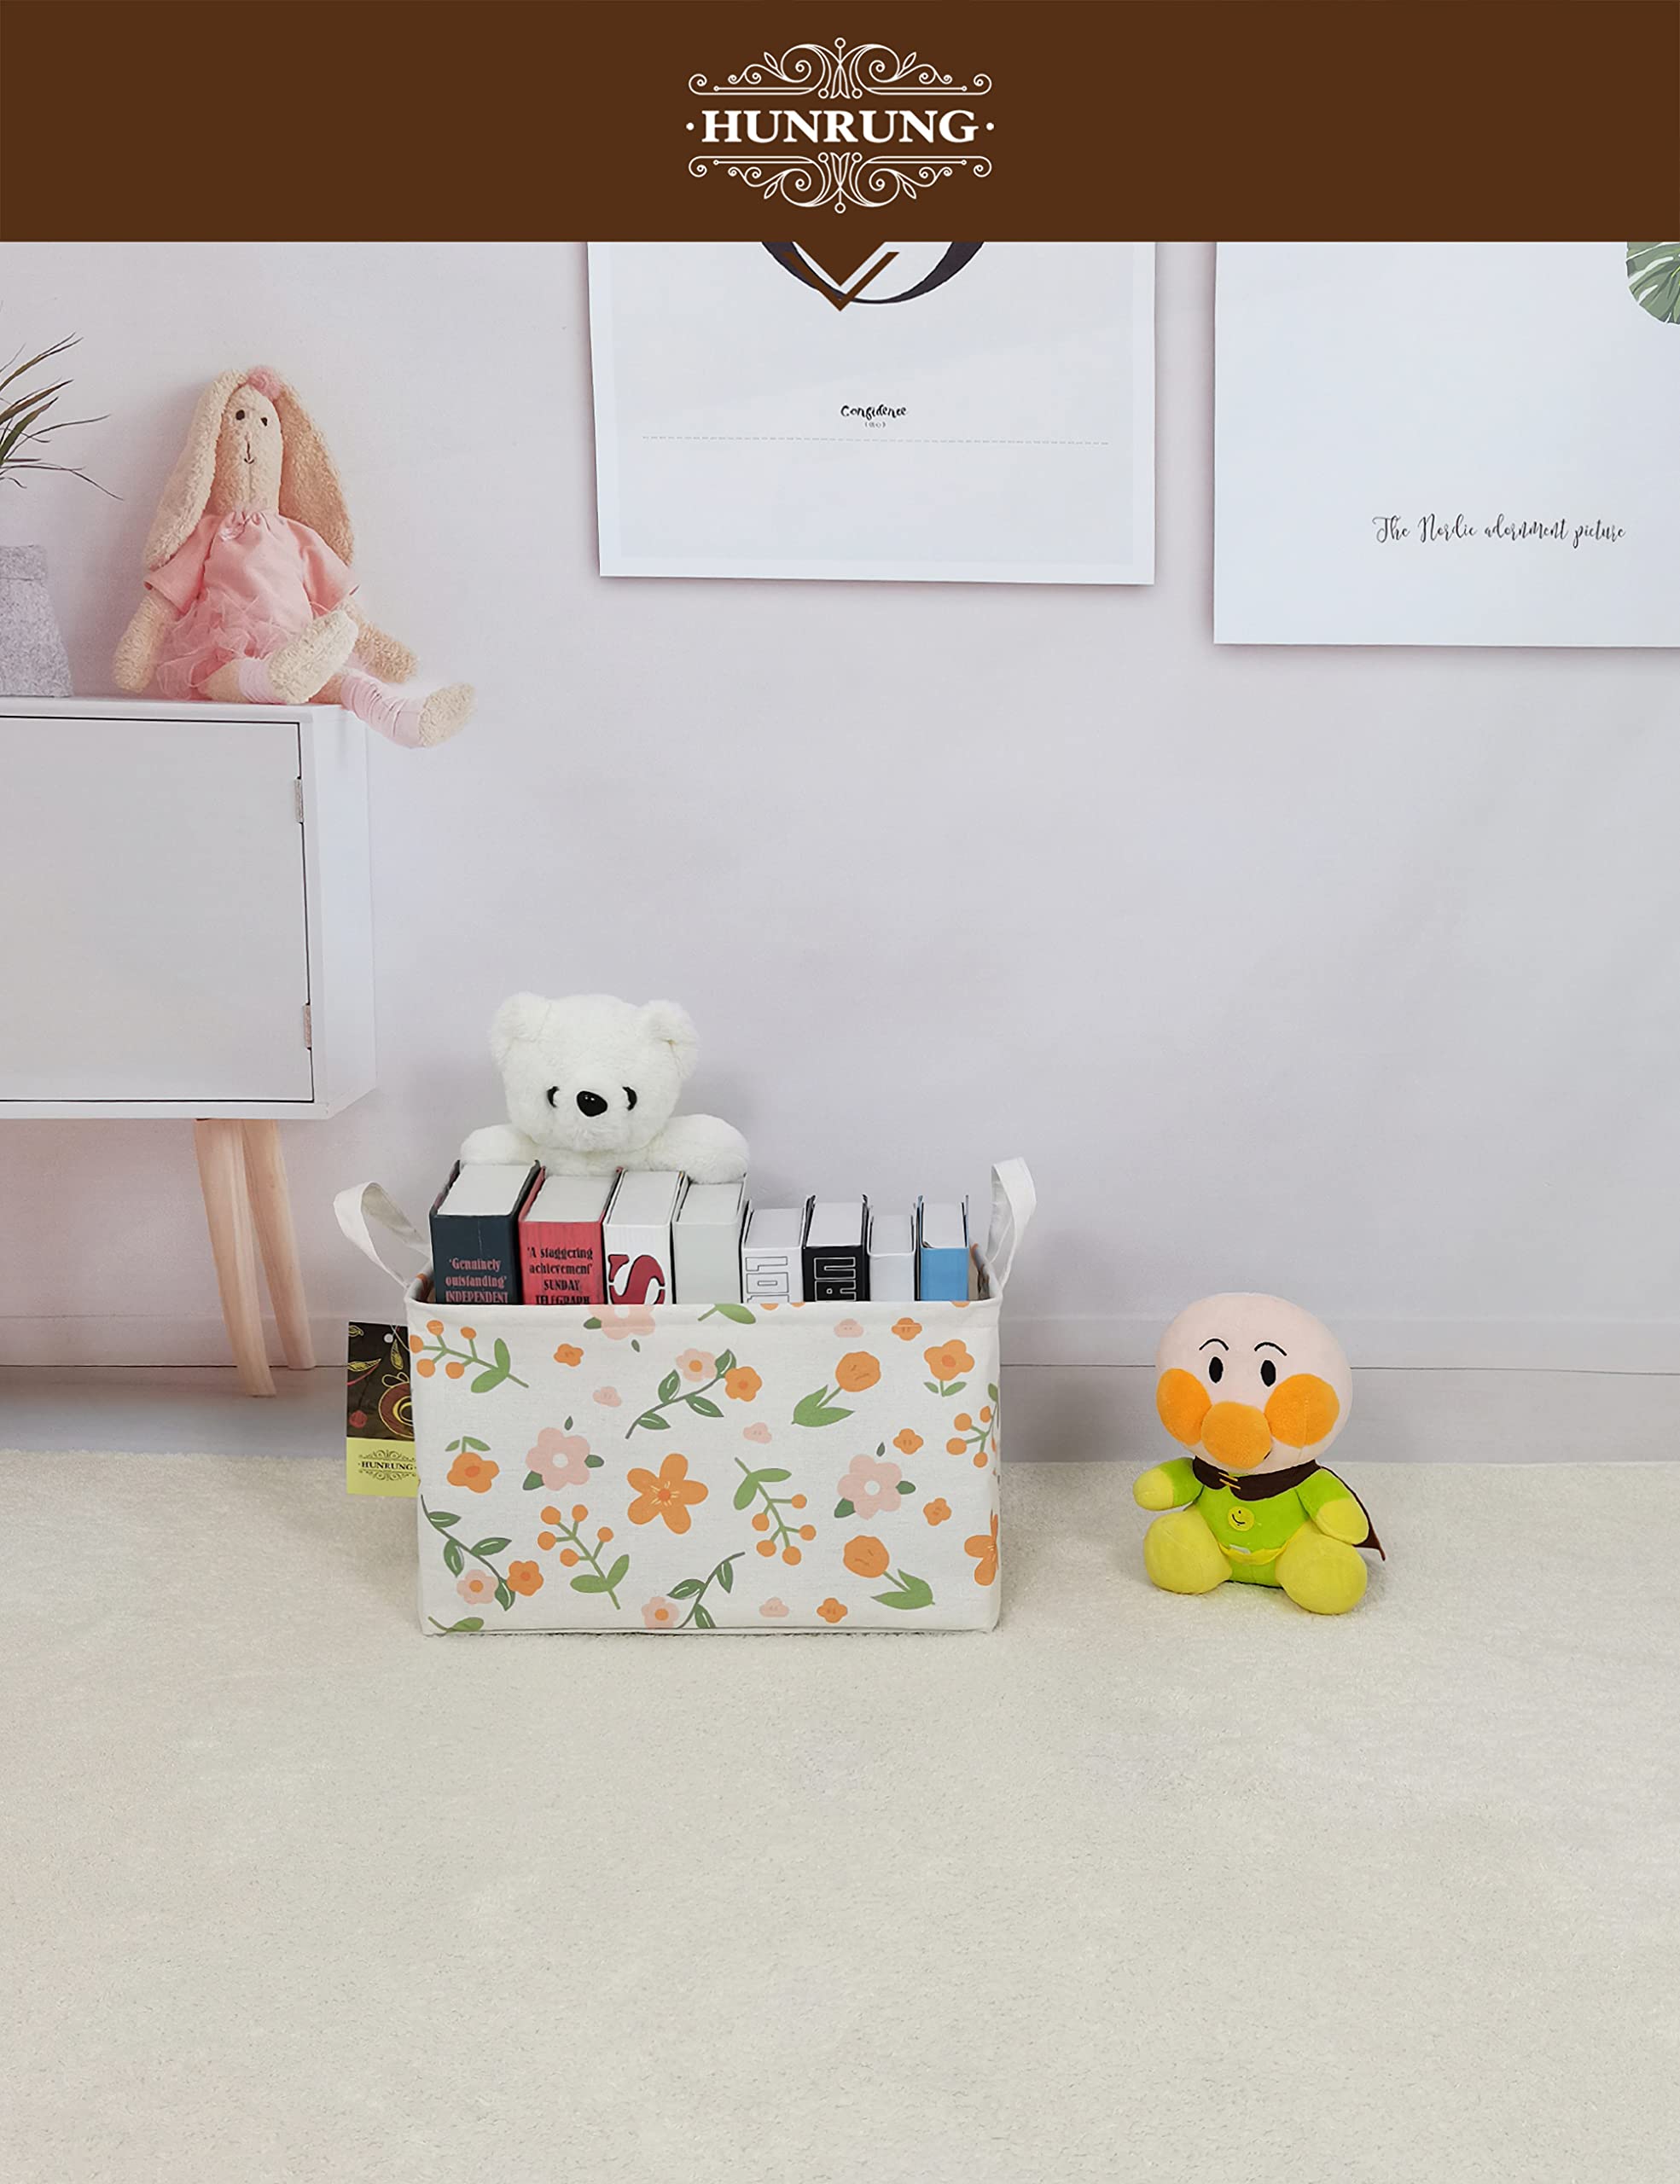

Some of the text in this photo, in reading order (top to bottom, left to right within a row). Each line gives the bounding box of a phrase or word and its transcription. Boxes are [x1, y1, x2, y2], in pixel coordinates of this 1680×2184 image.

[840, 404, 908, 421] Confidence
[1372, 513, 1626, 549] The Nordic adornment picture
[540, 1246, 594, 1260] staggering
[543, 1279, 581, 1292] SUNDAY
[445, 1290, 509, 1304] INDEPENDENT
[361, 1461, 414, 1471] HUNRUNG
